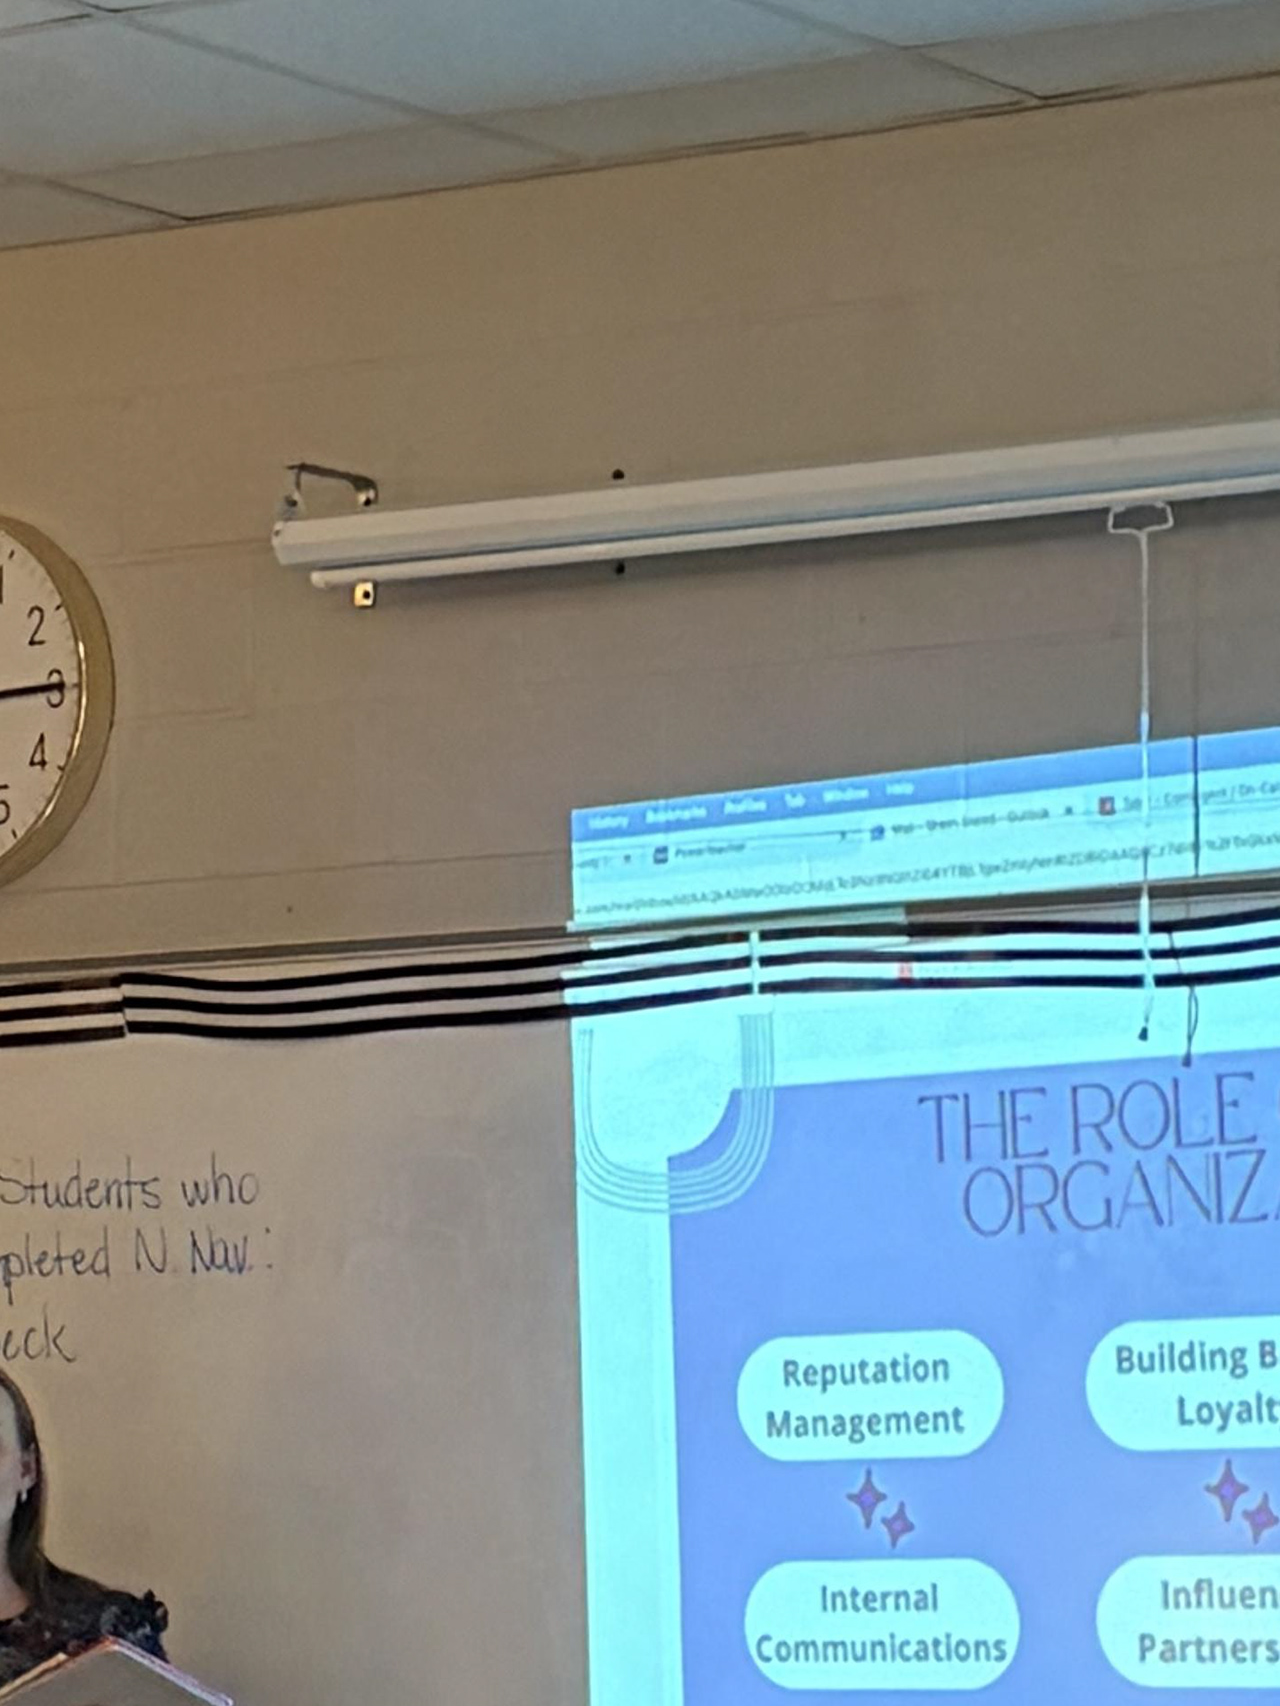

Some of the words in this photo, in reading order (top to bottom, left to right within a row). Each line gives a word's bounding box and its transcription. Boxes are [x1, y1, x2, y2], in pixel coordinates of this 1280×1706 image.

[26, 605, 47, 647] 2
[45, 669, 66, 709] 3
[28, 732, 49, 771] 4
[917, 1086, 1050, 1164] THE
[1070, 1070, 1258, 1156] ROLE
[180, 1151, 261, 1208] who
[782, 1352, 951, 1395] Reputation
[1115, 1340, 1248, 1380] Building
[766, 1405, 966, 1444] Management
[820, 1582, 939, 1613] Internal
[755, 1631, 1008, 1665] Communications
